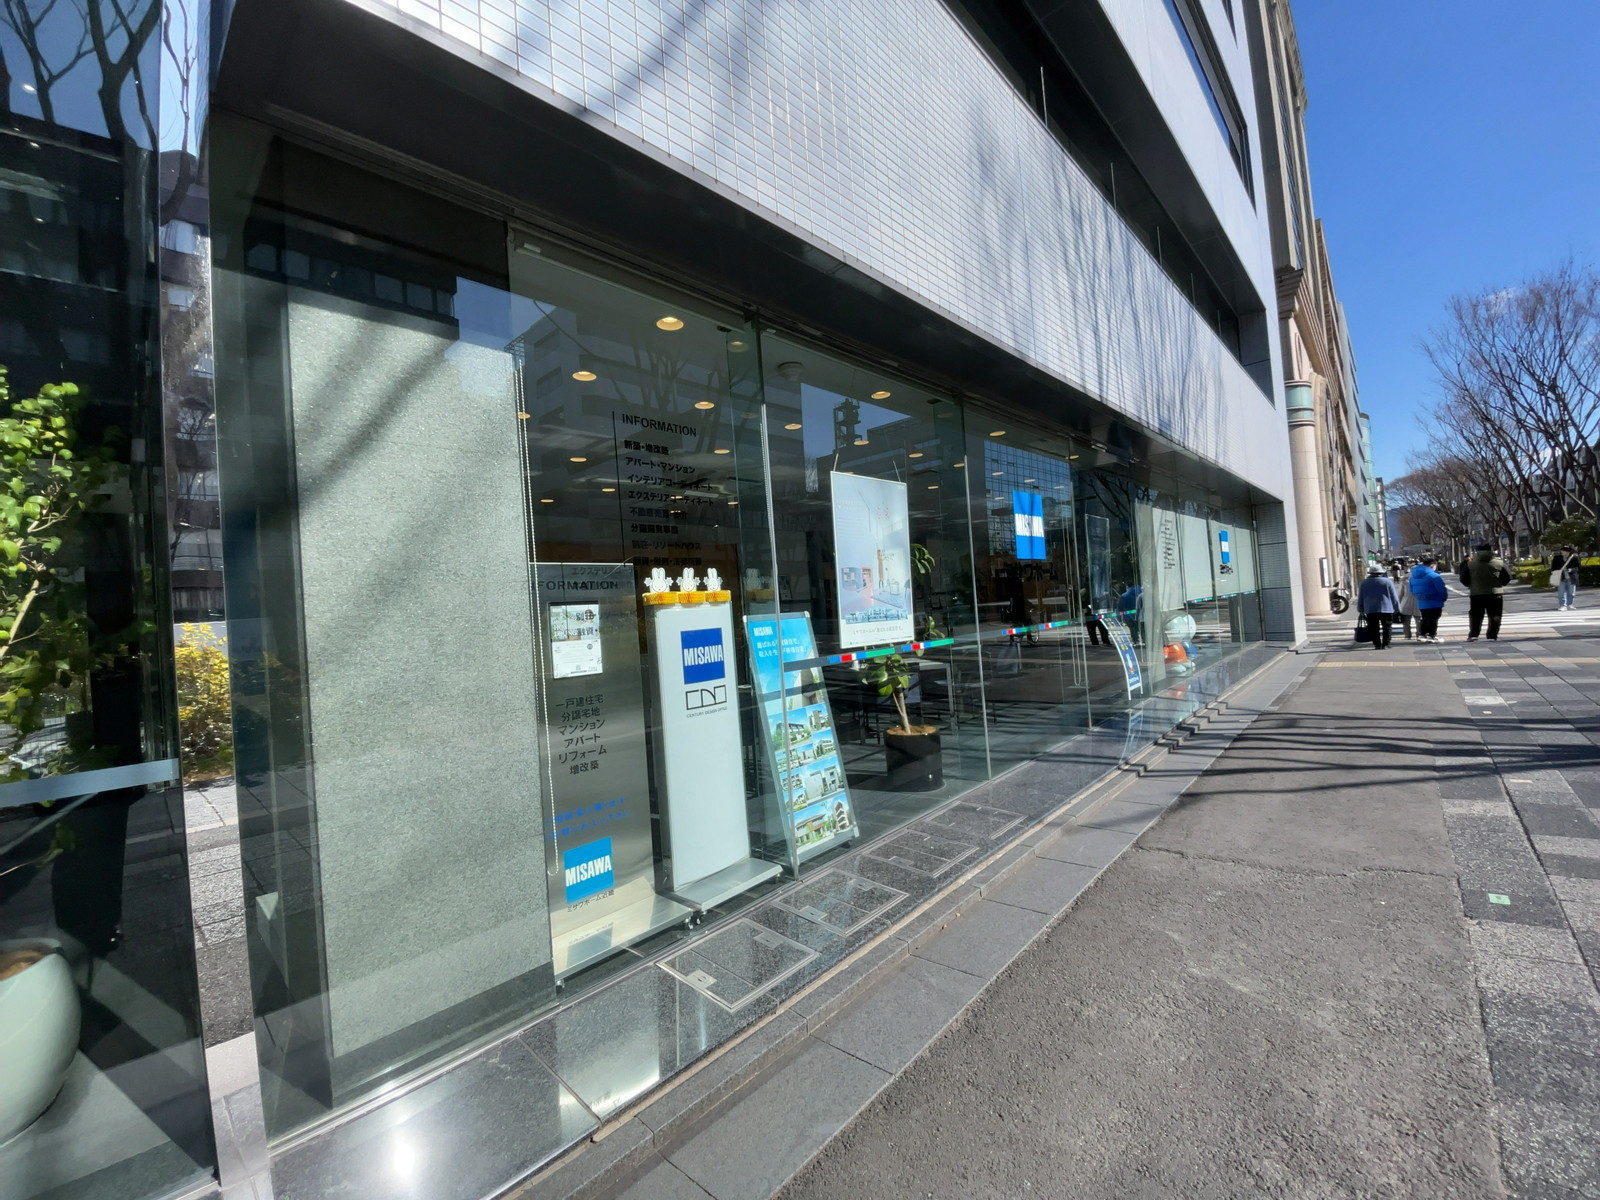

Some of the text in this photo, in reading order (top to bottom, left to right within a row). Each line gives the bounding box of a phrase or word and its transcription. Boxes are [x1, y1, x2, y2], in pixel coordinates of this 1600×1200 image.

[622, 413, 697, 437] INFORMATION
[625, 456, 696, 474] アパート・マンション
[683, 644, 724, 667] MISAWA
[555, 694, 604, 709] 一戸建住宅
[561, 706, 601, 722] 分譲宅地
[557, 719, 606, 736] マンション
[564, 733, 601, 749] アパート
[558, 744, 608, 764] リフォーム
[569, 760, 600, 775] 増改築
[565, 854, 612, 887] MISAWA
